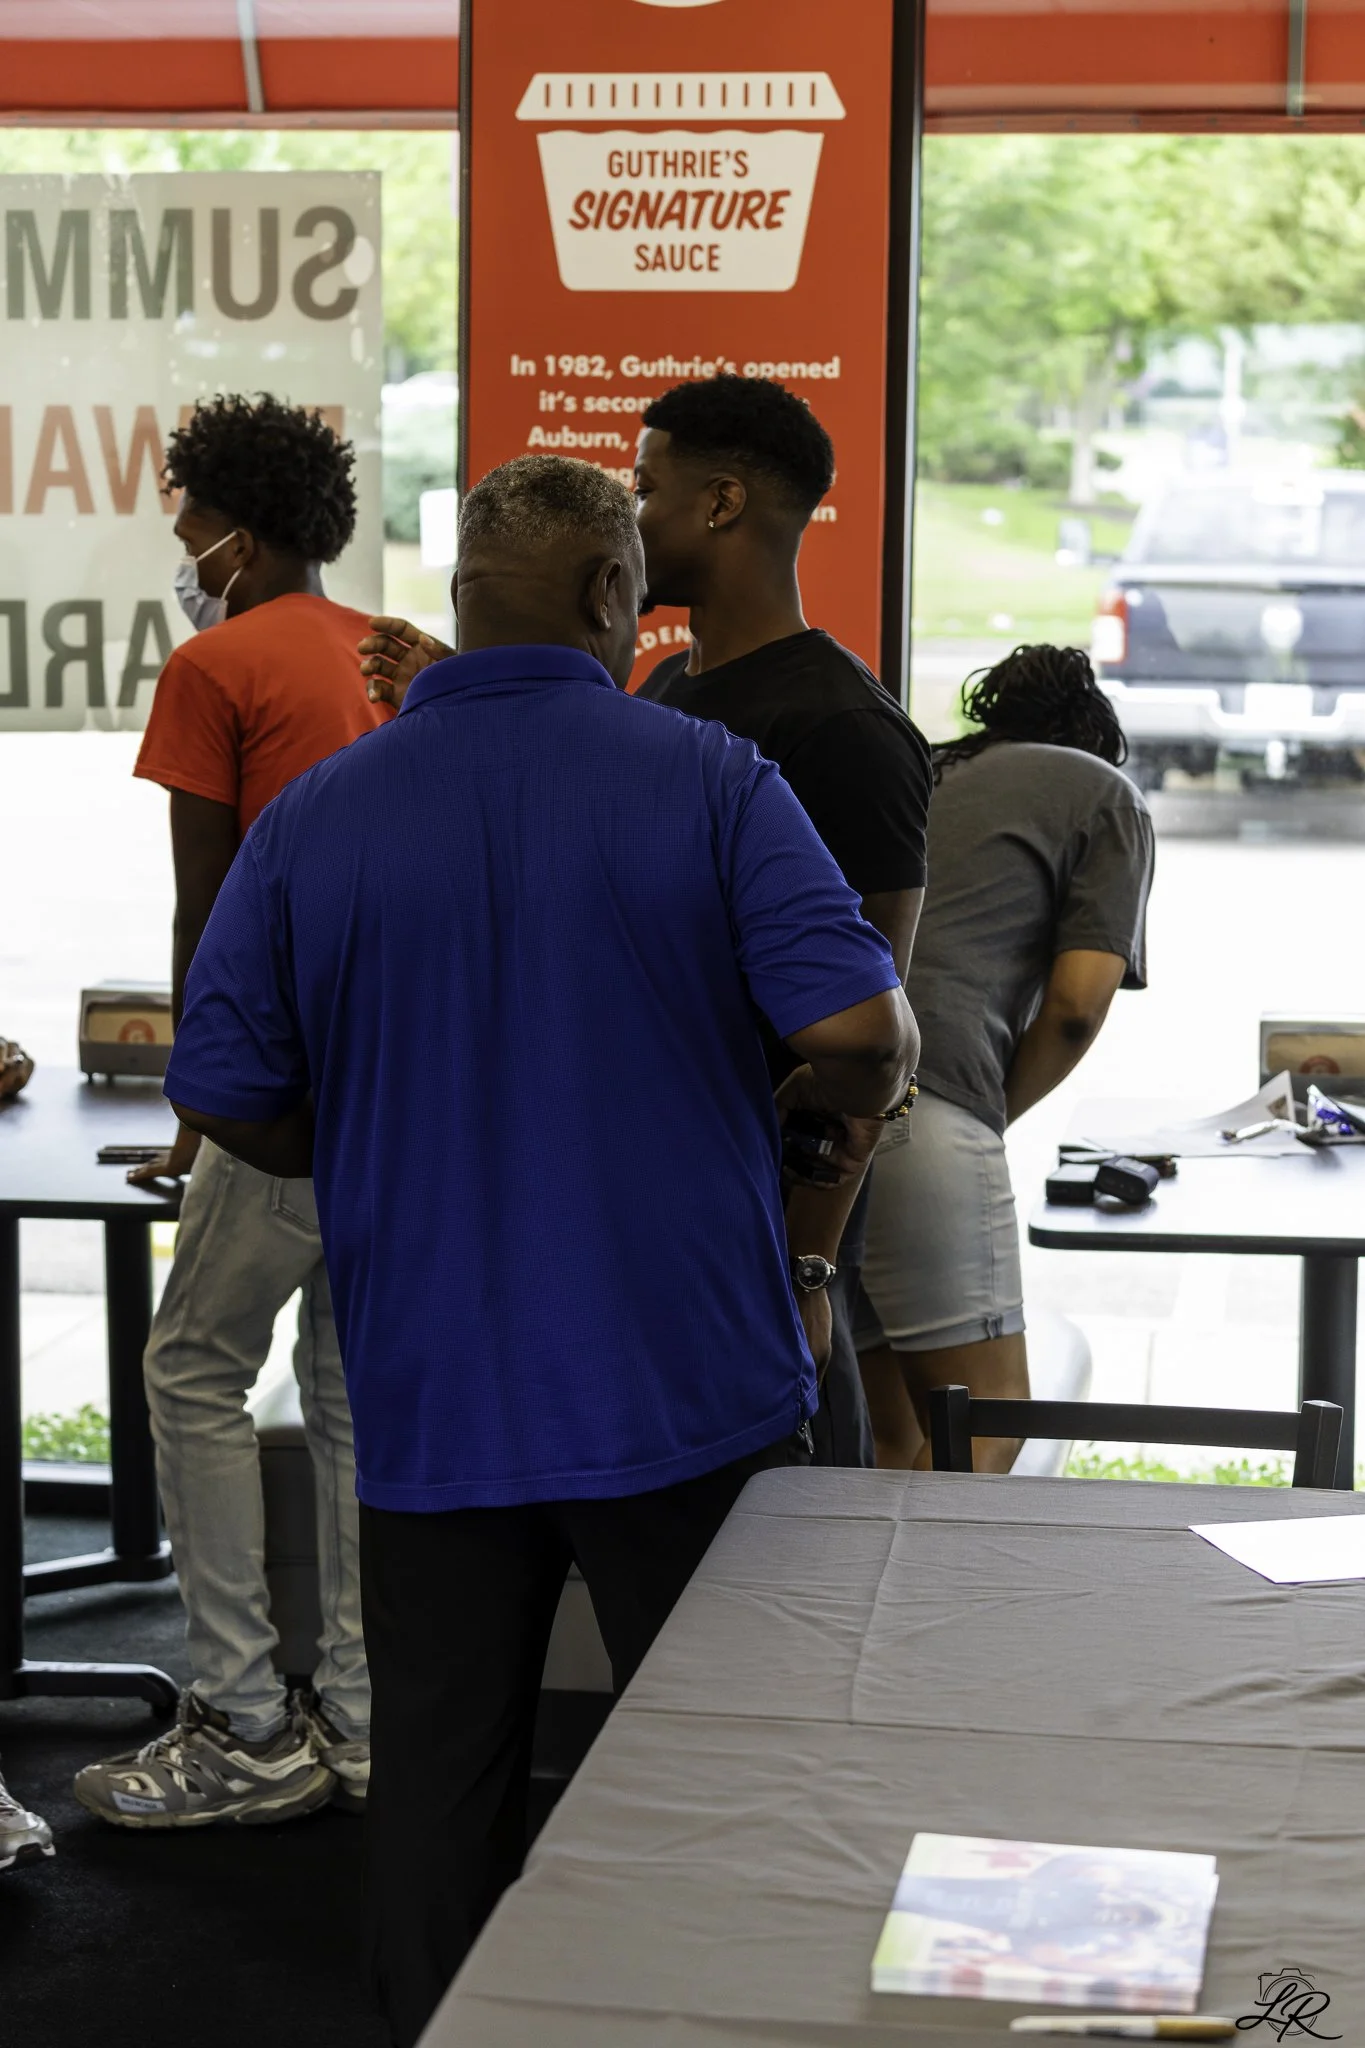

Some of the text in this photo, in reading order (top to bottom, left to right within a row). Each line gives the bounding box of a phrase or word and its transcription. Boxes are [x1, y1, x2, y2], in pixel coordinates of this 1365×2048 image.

[607, 150, 749, 178] GUTHRIE'S
[568, 189, 792, 231] SIGNATURE
[635, 244, 720, 272] SAUCE
[510, 354, 841, 381] In 1982, Guthrie's opened
[538, 389, 578, 413] it's
[526, 425, 630, 452] Auburn,
